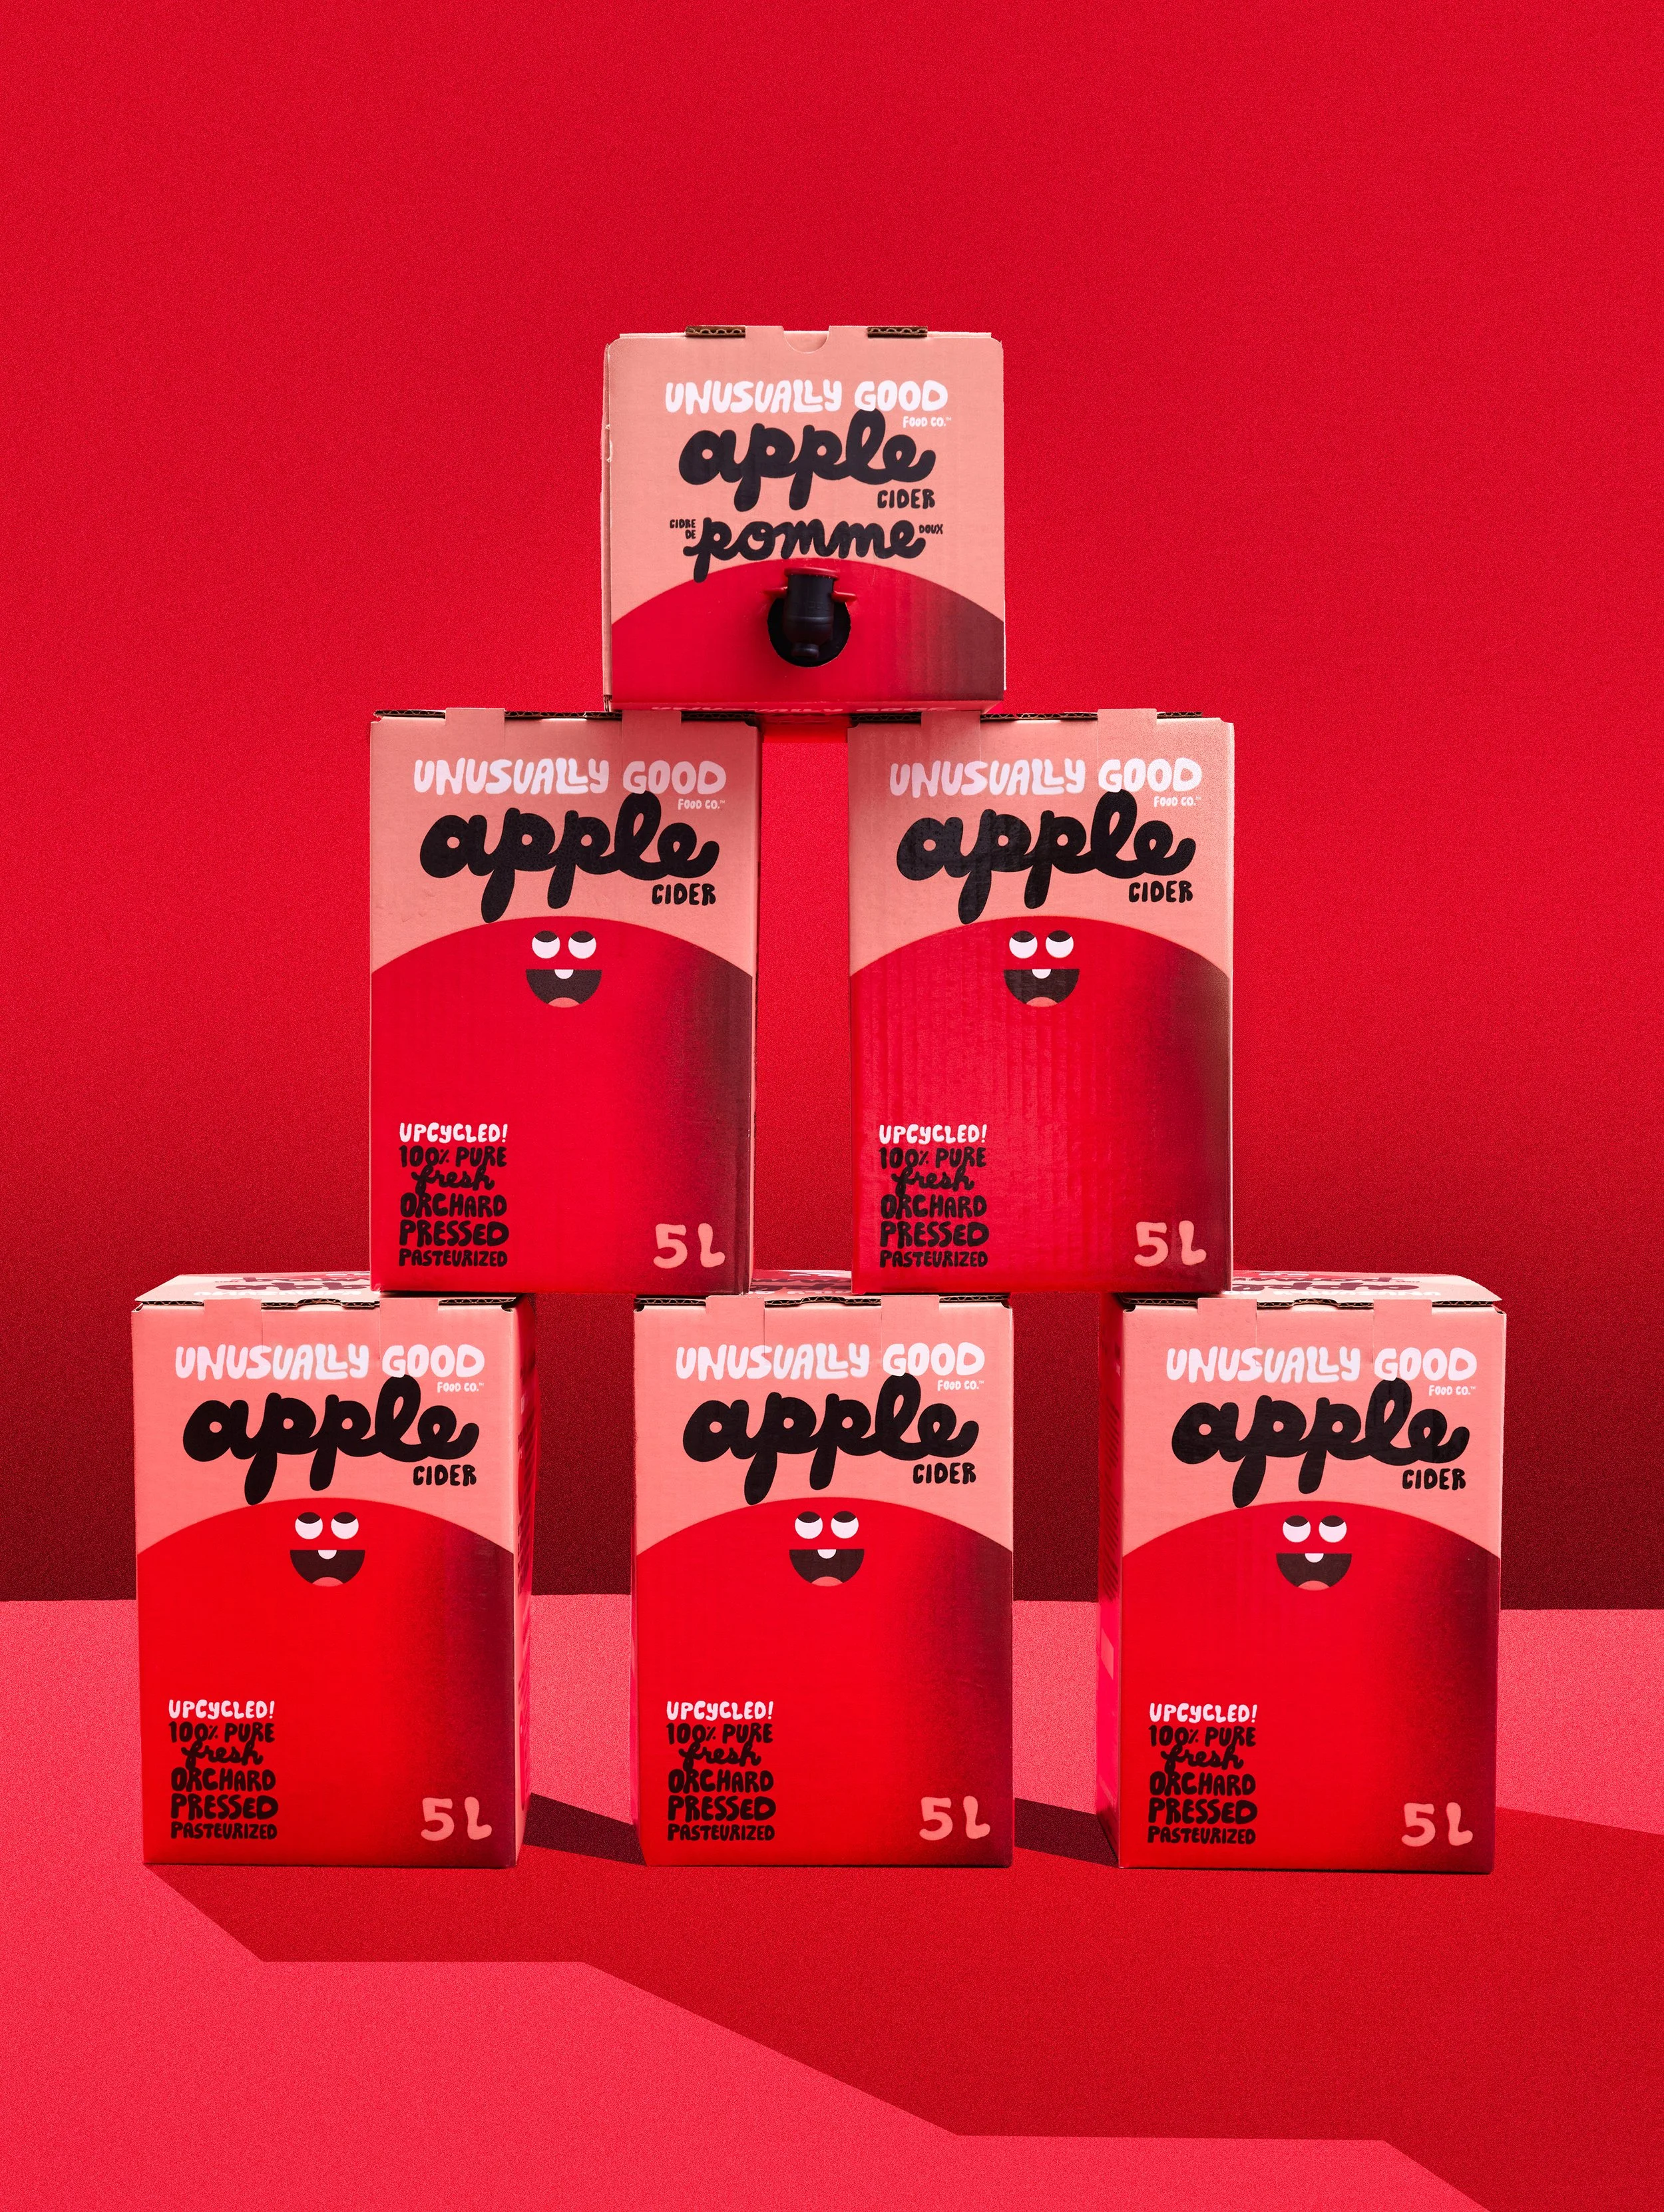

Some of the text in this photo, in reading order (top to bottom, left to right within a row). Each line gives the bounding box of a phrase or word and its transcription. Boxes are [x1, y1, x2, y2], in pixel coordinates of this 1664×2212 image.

[666, 379, 948, 414] UNUSUALLY GOOD
[903, 416, 928, 428] FOOD
[679, 409, 936, 511] apple
[877, 489, 935, 509] CIDER
[670, 519, 696, 529] CIDRE
[919, 524, 943, 535] DOUX
[683, 517, 926, 582] pomme
[413, 758, 726, 795] UNUSUALLY GOOD
[889, 758, 1202, 798] UNUSUALLY GOOD
[678, 799, 702, 810] FOOD
[1153, 795, 1178, 807] FOOD
[420, 791, 720, 923] apple
[897, 789, 1196, 925] apple
[652, 883, 716, 906] CIDER
[1129, 880, 1193, 903] CIDER
[399, 1122, 508, 1143] UPCYCLED!
[879, 1124, 988, 1144] UPCYCLED!
[399, 1145, 507, 1167] 100% PURE
[879, 1146, 987, 1170] 100% PURE
[411, 1164, 495, 1196] fresh
[891, 1165, 975, 1196] fresh
[401, 1192, 507, 1218] ORCHARD
[881, 1194, 987, 1219] ORCHARD
[400, 1219, 509, 1247] PRESSED
[880, 1221, 989, 1249] PRESSED
[399, 1248, 508, 1267] PASTEURIZED
[879, 1250, 988, 1267] PASTEURIZED
[175, 1344, 485, 1381] UNUSUALLY GOOD
[676, 1341, 985, 1381] UNUSUALLY GOOD
[1166, 1346, 1477, 1383] UNUSUALLY GOOD
[437, 1381, 461, 1393] FOOD
[937, 1379, 962, 1391] FOOD
[1428, 1384, 1453, 1396] FOOD
[182, 1374, 479, 1505] apple
[682, 1372, 979, 1506] apple
[1171, 1377, 1470, 1508] apple
[413, 1464, 477, 1486] CIDER
[913, 1462, 976, 1484] CIDER
[1402, 1468, 1466, 1490] CIDER
[168, 1699, 275, 1719] UPCYCLED!
[666, 1701, 773, 1721] UPCYCLED!
[1149, 1703, 1257, 1723] UPCYCLED!
[168, 1721, 275, 1743] 100% PURE
[666, 1723, 773, 1744] 100% PURE
[1148, 1725, 1256, 1747] 100% PURE
[181, 1740, 264, 1771] fresh
[678, 1741, 761, 1771] fresh
[1161, 1743, 1244, 1775] fresh
[171, 1767, 276, 1792] ORCHARD
[668, 1769, 774, 1794] ORCHARD
[1149, 1771, 1256, 1797] ORCHARD
[170, 1793, 279, 1821] PRESSED
[668, 1795, 776, 1823] PRESSED
[1148, 1797, 1257, 1825] PRESSED
[170, 1821, 278, 1840] PASTEURIZED
[667, 1823, 775, 1841] PASTEURIZED
[1147, 1825, 1256, 1845] PASTEURIZED
